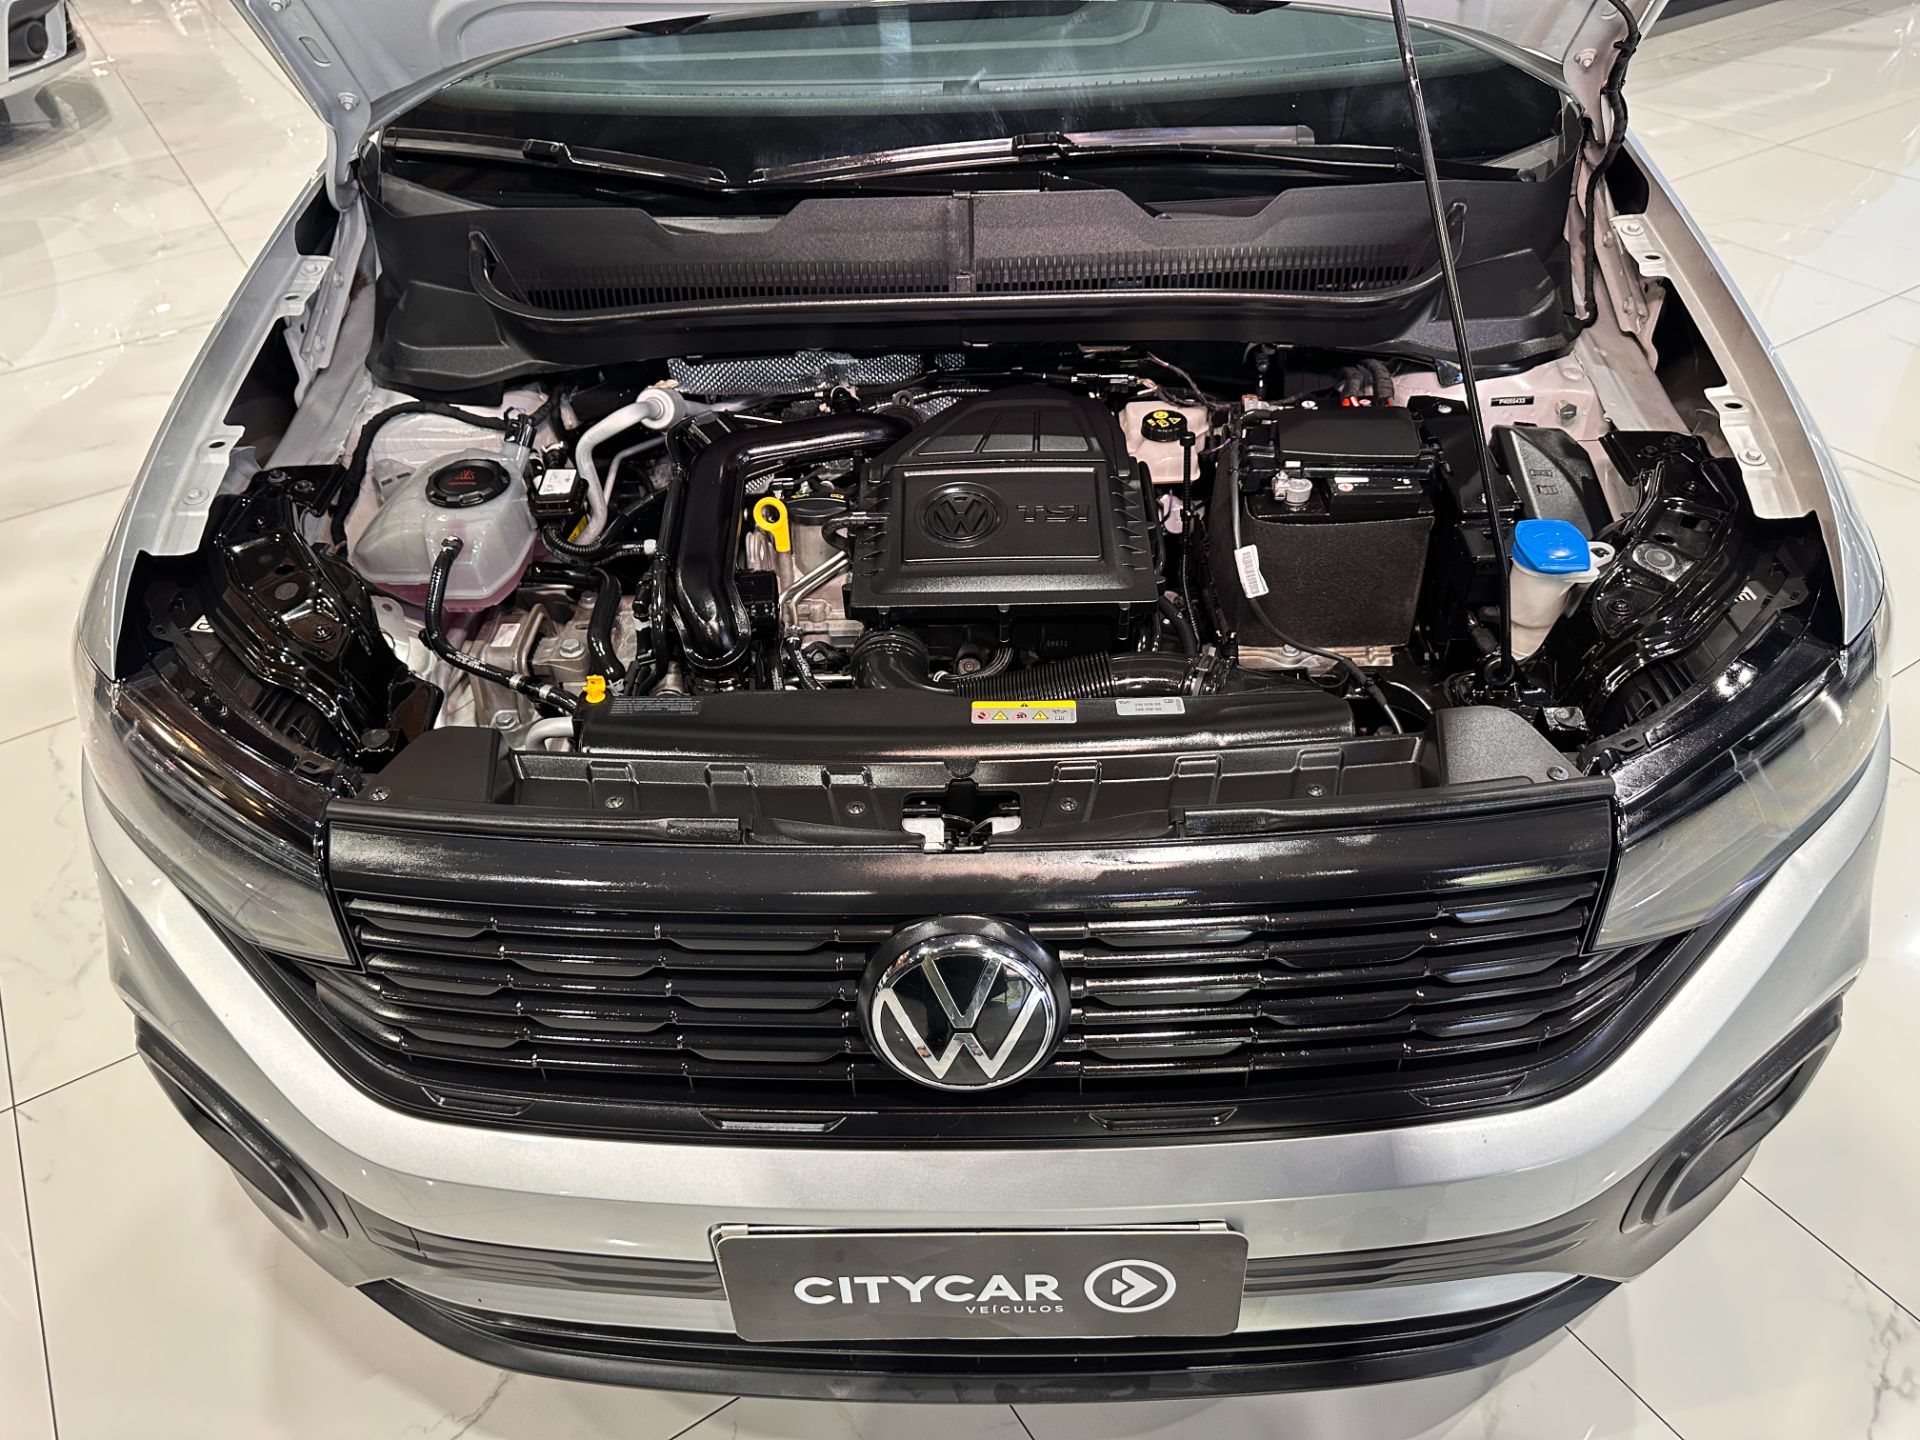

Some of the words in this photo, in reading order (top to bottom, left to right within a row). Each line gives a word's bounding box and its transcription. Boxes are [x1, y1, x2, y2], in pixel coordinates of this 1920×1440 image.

[1017, 504, 1089, 523] TSI
[877, 946, 1051, 1083] VW
[794, 1274, 1063, 1305] CITYCAR
[965, 1305, 1064, 1315] VEÍCULOS
